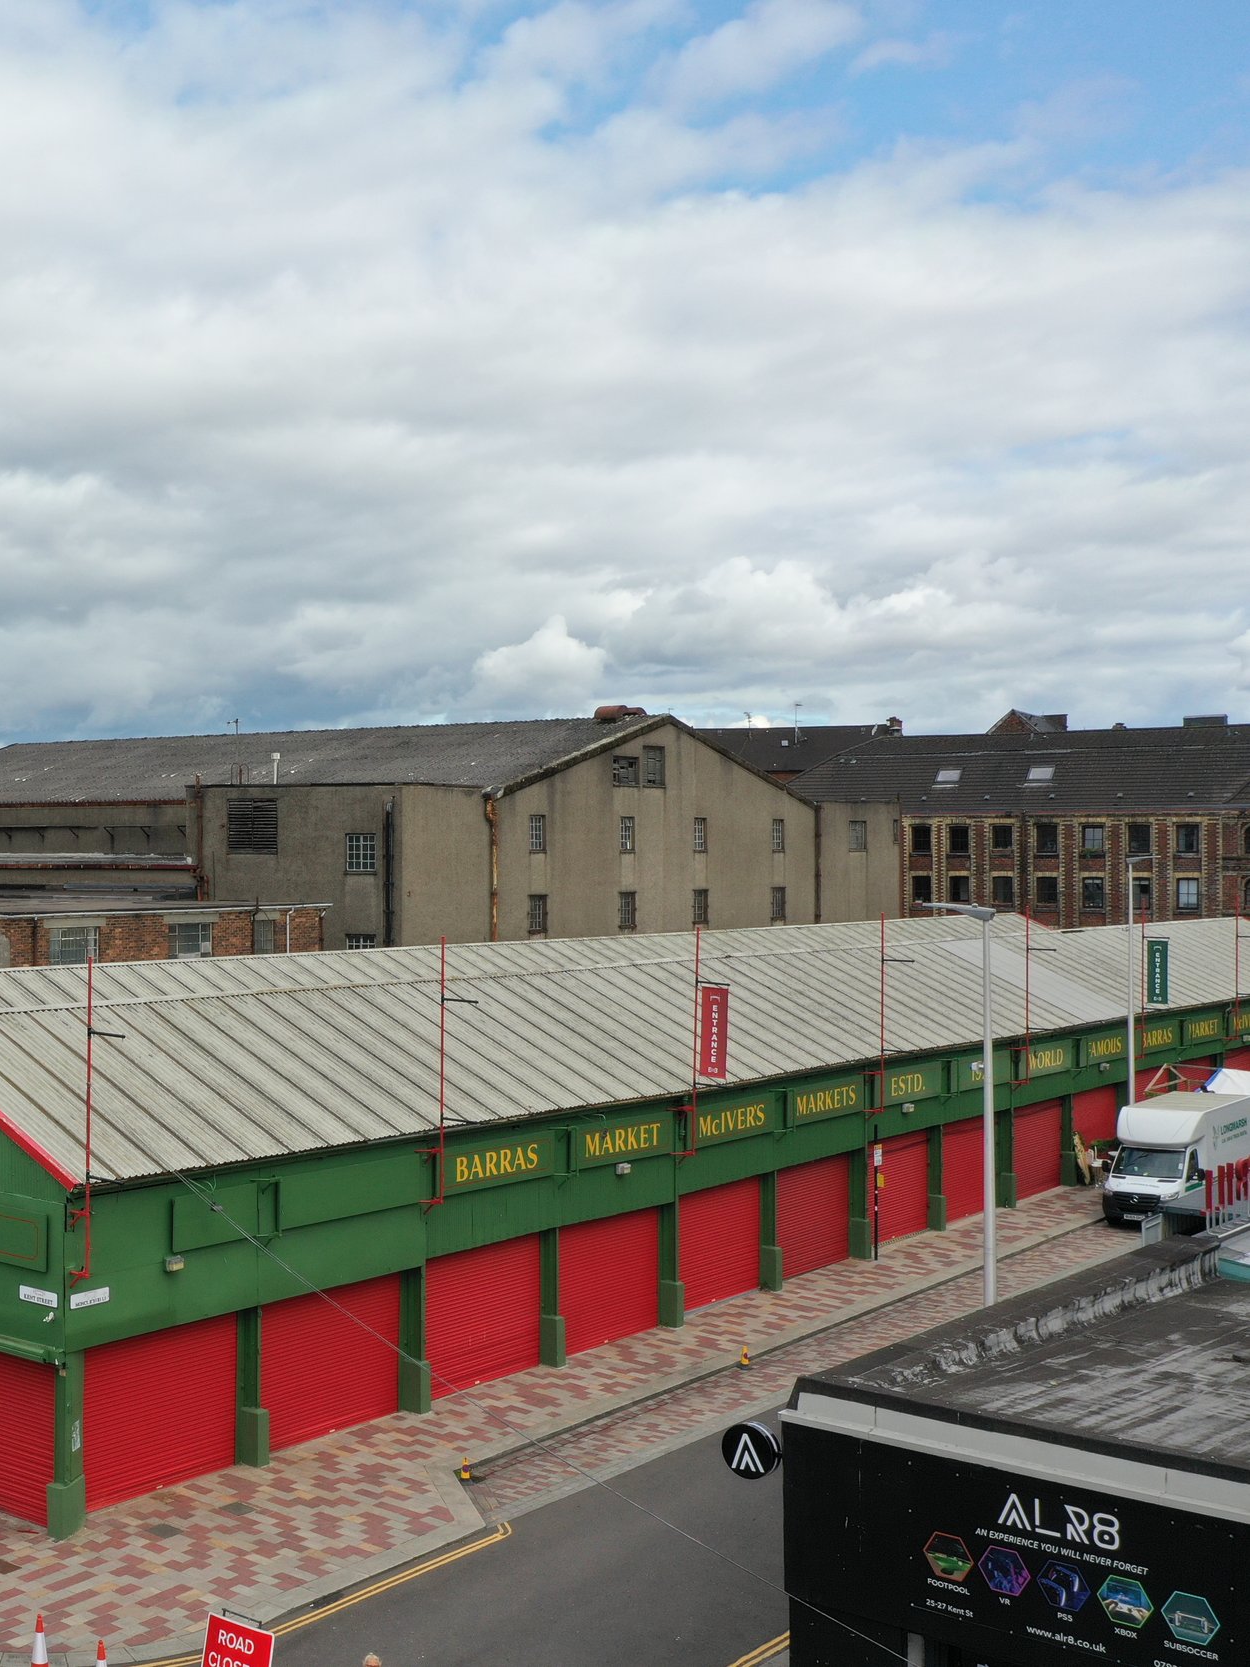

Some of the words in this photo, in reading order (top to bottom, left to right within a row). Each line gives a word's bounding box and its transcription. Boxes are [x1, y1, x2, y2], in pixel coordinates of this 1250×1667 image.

[710, 1004, 718, 1063] ENTRANCE
[456, 1144, 538, 1182] BARRAS
[585, 1123, 661, 1158] MARKET
[699, 1104, 766, 1138] McIVER'S
[796, 1085, 856, 1116] MARKETS
[891, 1073, 926, 1096] ESTD.
[1028, 1048, 1064, 1070] WORLD
[997, 1493, 1120, 1550] ALR8
[975, 1527, 988, 1537] AN
[989, 1530, 1039, 1549] EXPERIENCE
[1040, 1542, 1059, 1554] YOU
[1060, 1547, 1081, 1560] WILL
[1083, 1553, 1112, 1567] NEVER
[1112, 1560, 1149, 1576] FORGET
[927, 1577, 971, 1596] FOOTPOOL
[925, 1599, 947, 1610] 25-27
[947, 1604, 965, 1616] Kent
[965, 1610, 974, 1618] St
[999, 1596, 1011, 1606] VR
[1057, 1611, 1074, 1622] PS5
[218, 1629, 255, 1655] ROAD
[1026, 1625, 1107, 1653] www.alr8.co.uk
[1114, 1627, 1138, 1640] XBOX
[208, 1651, 250, 1667] CLO
[1163, 1640, 1219, 1661] SUBSOCCER
